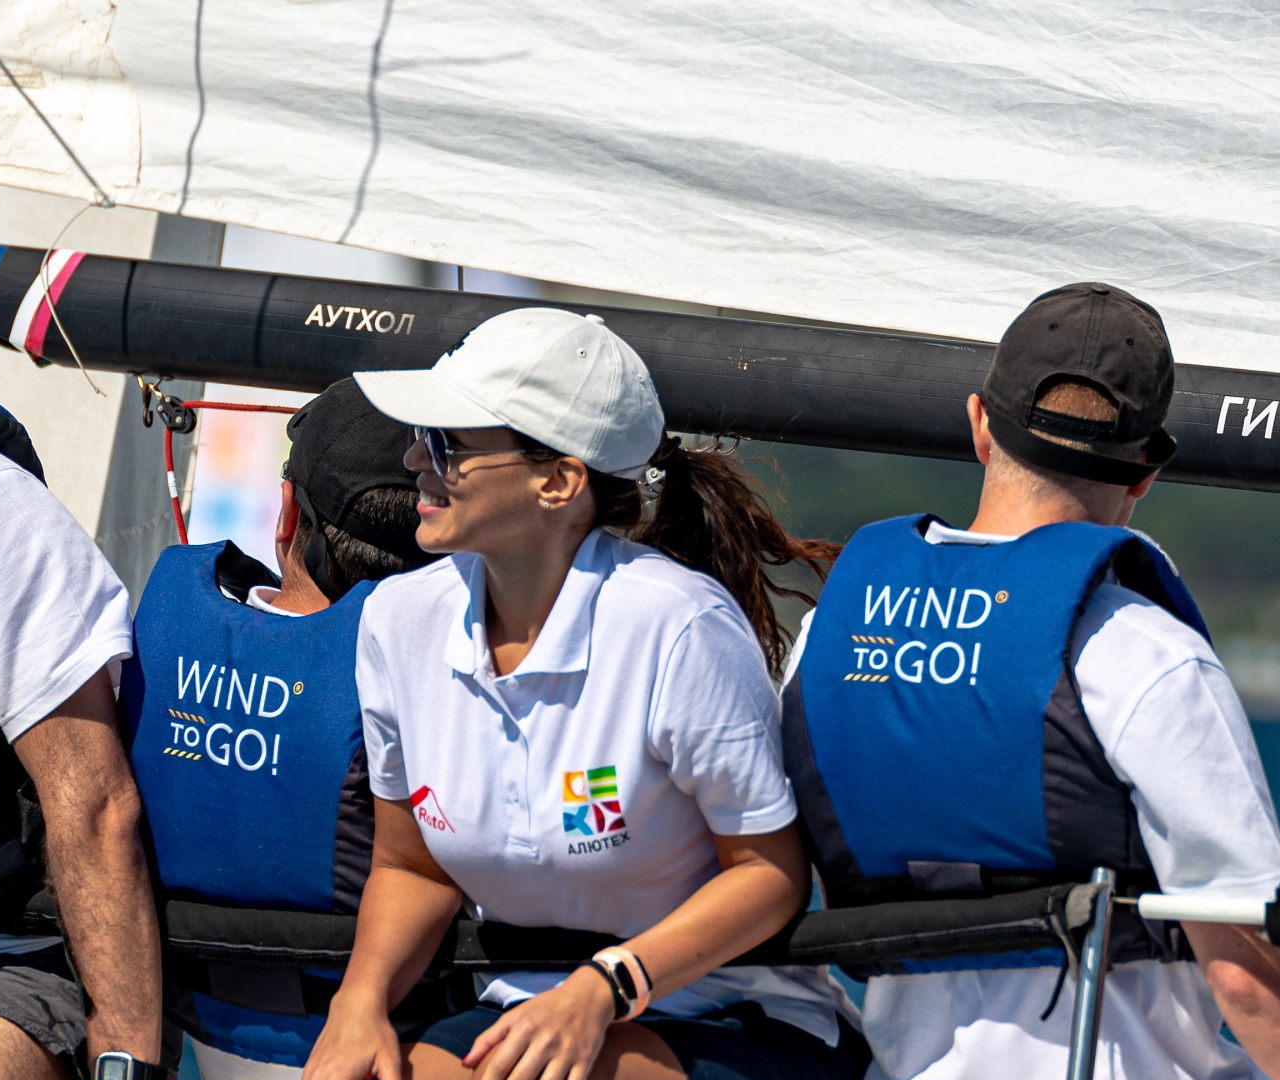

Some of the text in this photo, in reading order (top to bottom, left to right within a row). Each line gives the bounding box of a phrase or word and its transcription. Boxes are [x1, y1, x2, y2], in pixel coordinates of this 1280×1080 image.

[304, 303, 416, 335] АУТХОЛ
[853, 640, 981, 686] TO GO!
[170, 722, 281, 776] TO GO!
[418, 806, 446, 831] Roto
[567, 831, 631, 856] АЛЮТЕХ
